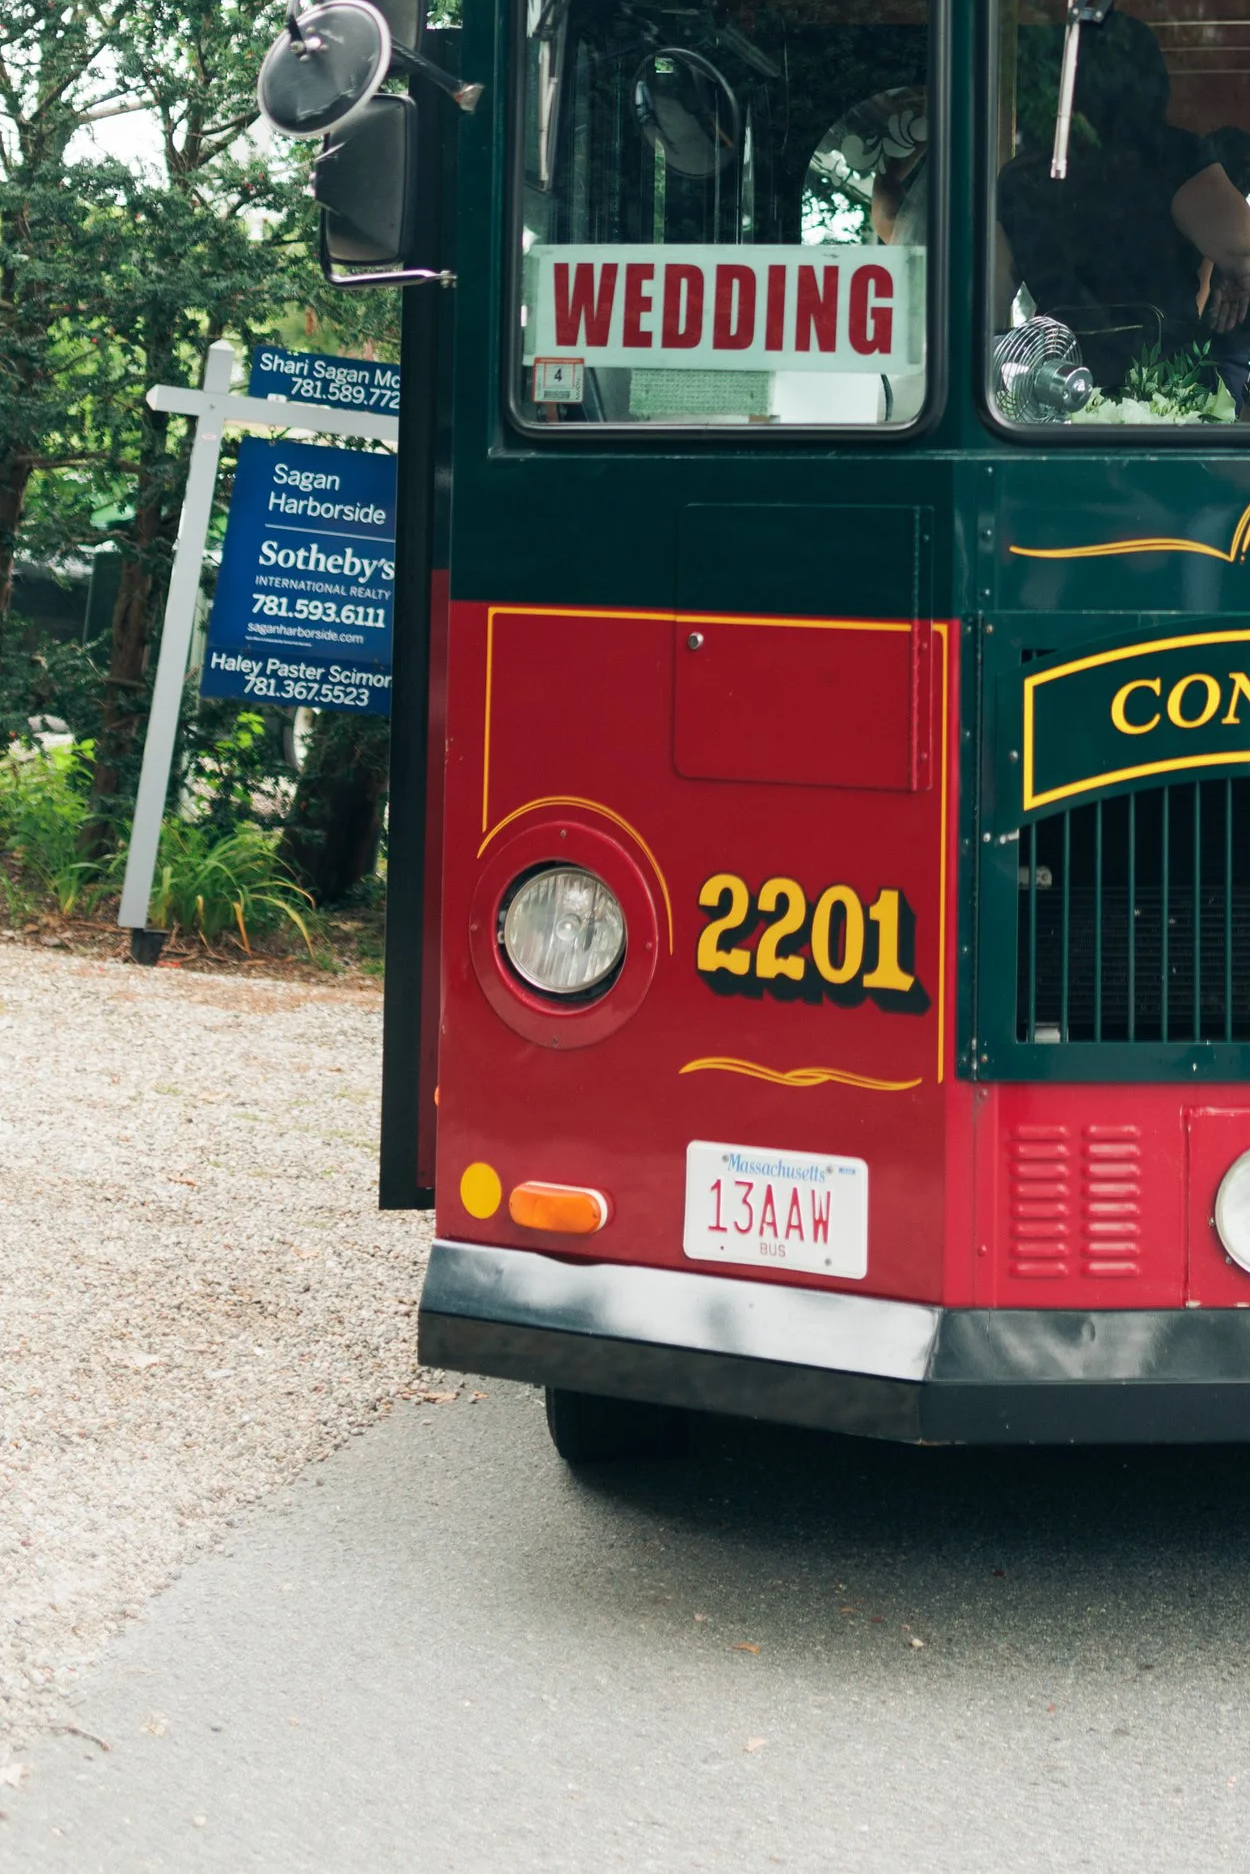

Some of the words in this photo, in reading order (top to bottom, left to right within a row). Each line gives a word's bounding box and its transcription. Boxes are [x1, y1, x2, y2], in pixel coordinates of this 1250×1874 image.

[553, 262, 894, 356] WEDDING
[260, 352, 309, 376] Shari
[313, 360, 369, 385] Sagan
[291, 377, 400, 409] 781.589.772
[273, 463, 340, 492] Sagan
[268, 491, 386, 525] Harborside
[258, 540, 395, 584] Sotheby's
[255, 575, 347, 596] INTERNATIONAL
[349, 586, 392, 601] REALTY
[251, 593, 386, 628] 781.593.6111
[247, 622, 364, 644] saganharborside.com
[210, 652, 263, 675] Haley
[266, 658, 325, 681] Paster
[243, 675, 370, 707] 781.367.5523
[697, 873, 917, 994] 2201
[728, 1153, 826, 1183] Massachusetts
[708, 1179, 832, 1245] 13AAW
[760, 1242, 786, 1258] BUS
